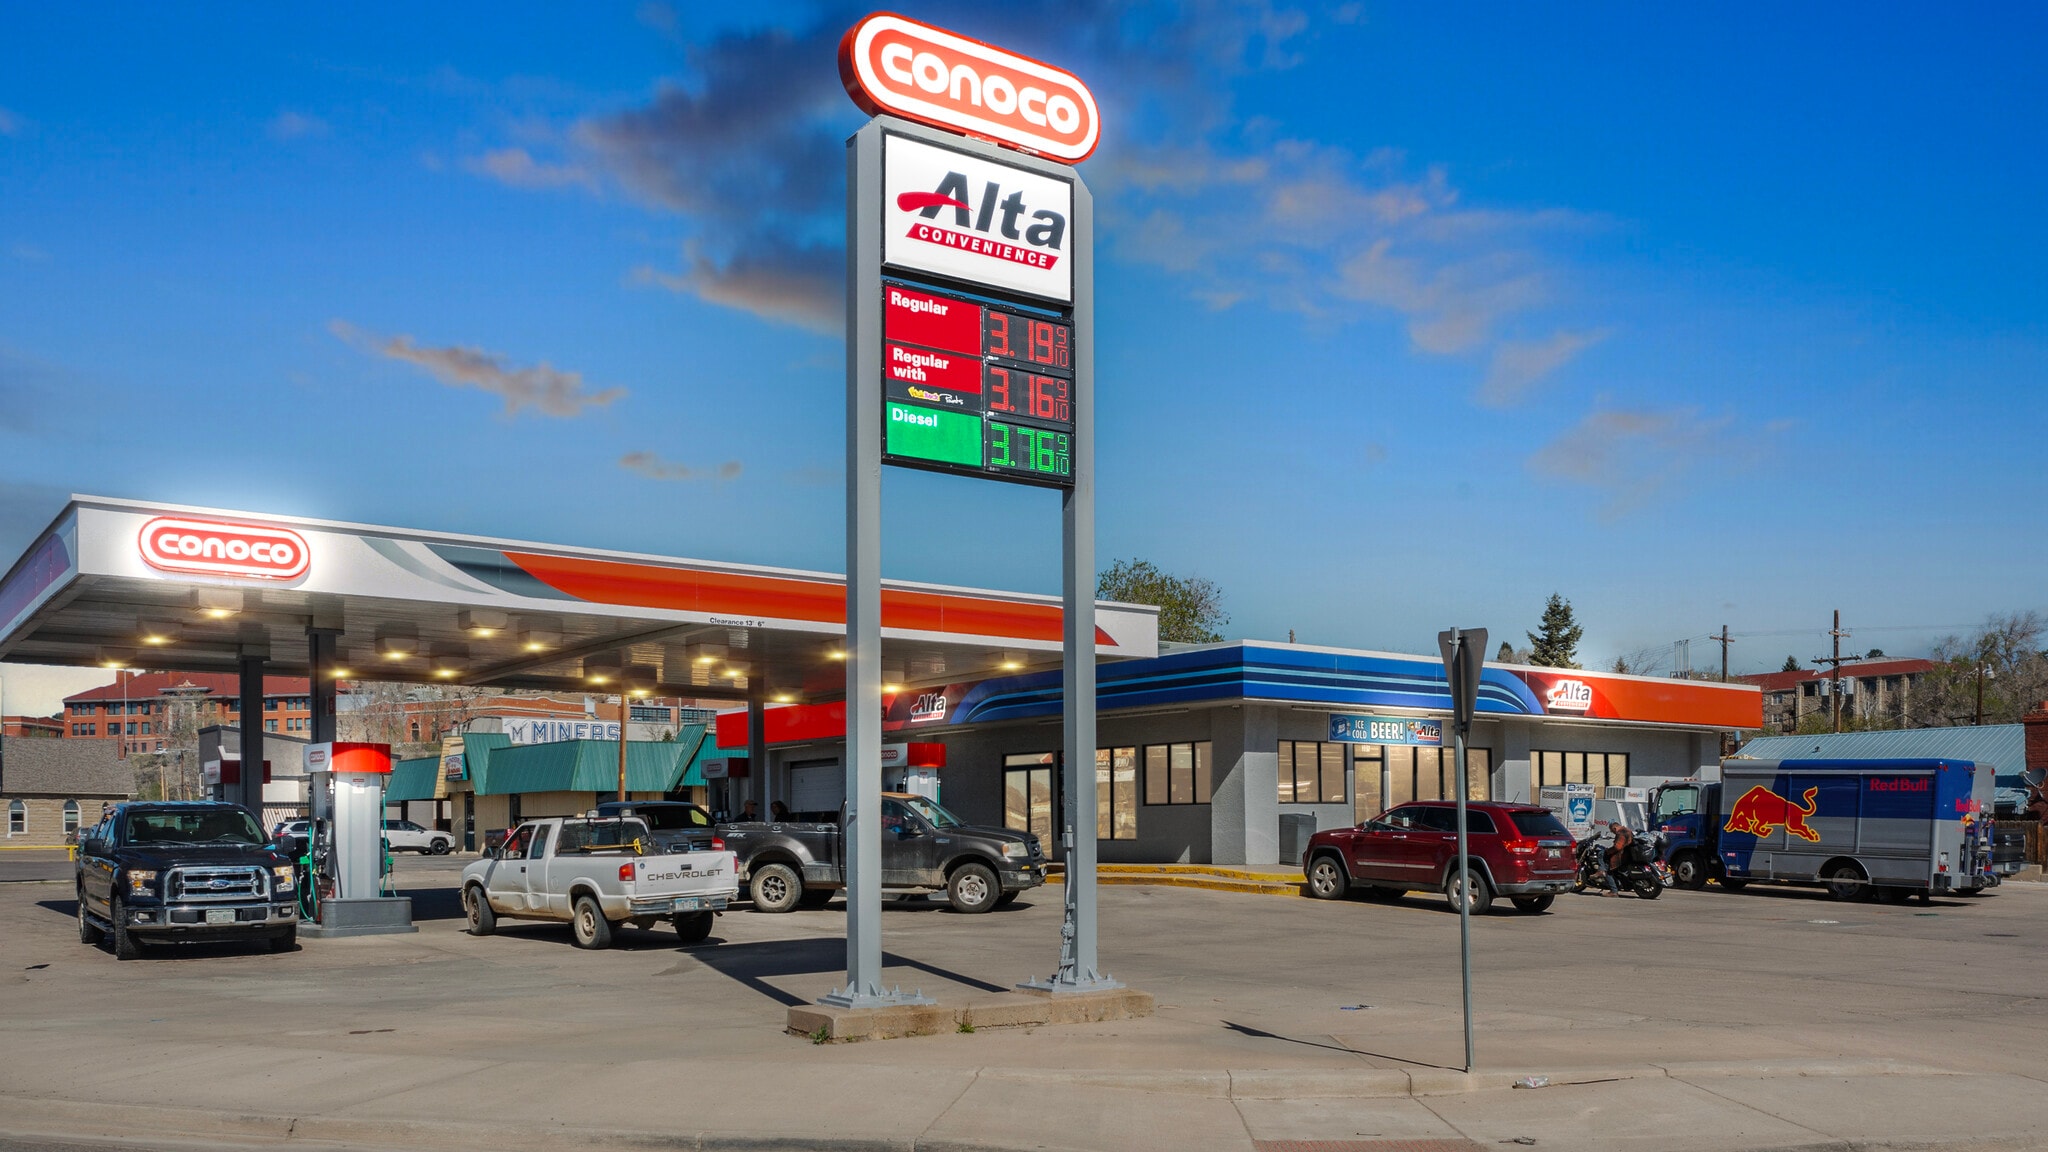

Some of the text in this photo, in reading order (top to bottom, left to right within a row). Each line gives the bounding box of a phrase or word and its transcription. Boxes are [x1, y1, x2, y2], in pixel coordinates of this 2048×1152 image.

[912, 170, 1067, 251] Alta
[918, 225, 1048, 268] CONVENIENCE
[890, 291, 949, 316] Regular
[989, 311, 1054, 365] 3.19
[892, 347, 949, 370] Regular
[892, 365, 927, 381] with
[989, 367, 1054, 419] 3.16
[892, 407, 938, 428] Diesel
[990, 422, 1055, 473] 3.76
[709, 617, 744, 627] Clearance
[1556, 682, 1591, 702] Alta
[914, 693, 946, 713] Alta
[531, 720, 621, 744] MINERS
[1352, 729, 1368, 740] COLD
[1354, 720, 1365, 729] ICE
[1370, 721, 1404, 740] BEER!
[1418, 724, 1441, 737] Alta
[1869, 778, 1929, 792] Red Bull
[647, 868, 724, 882] CHEVROLET
